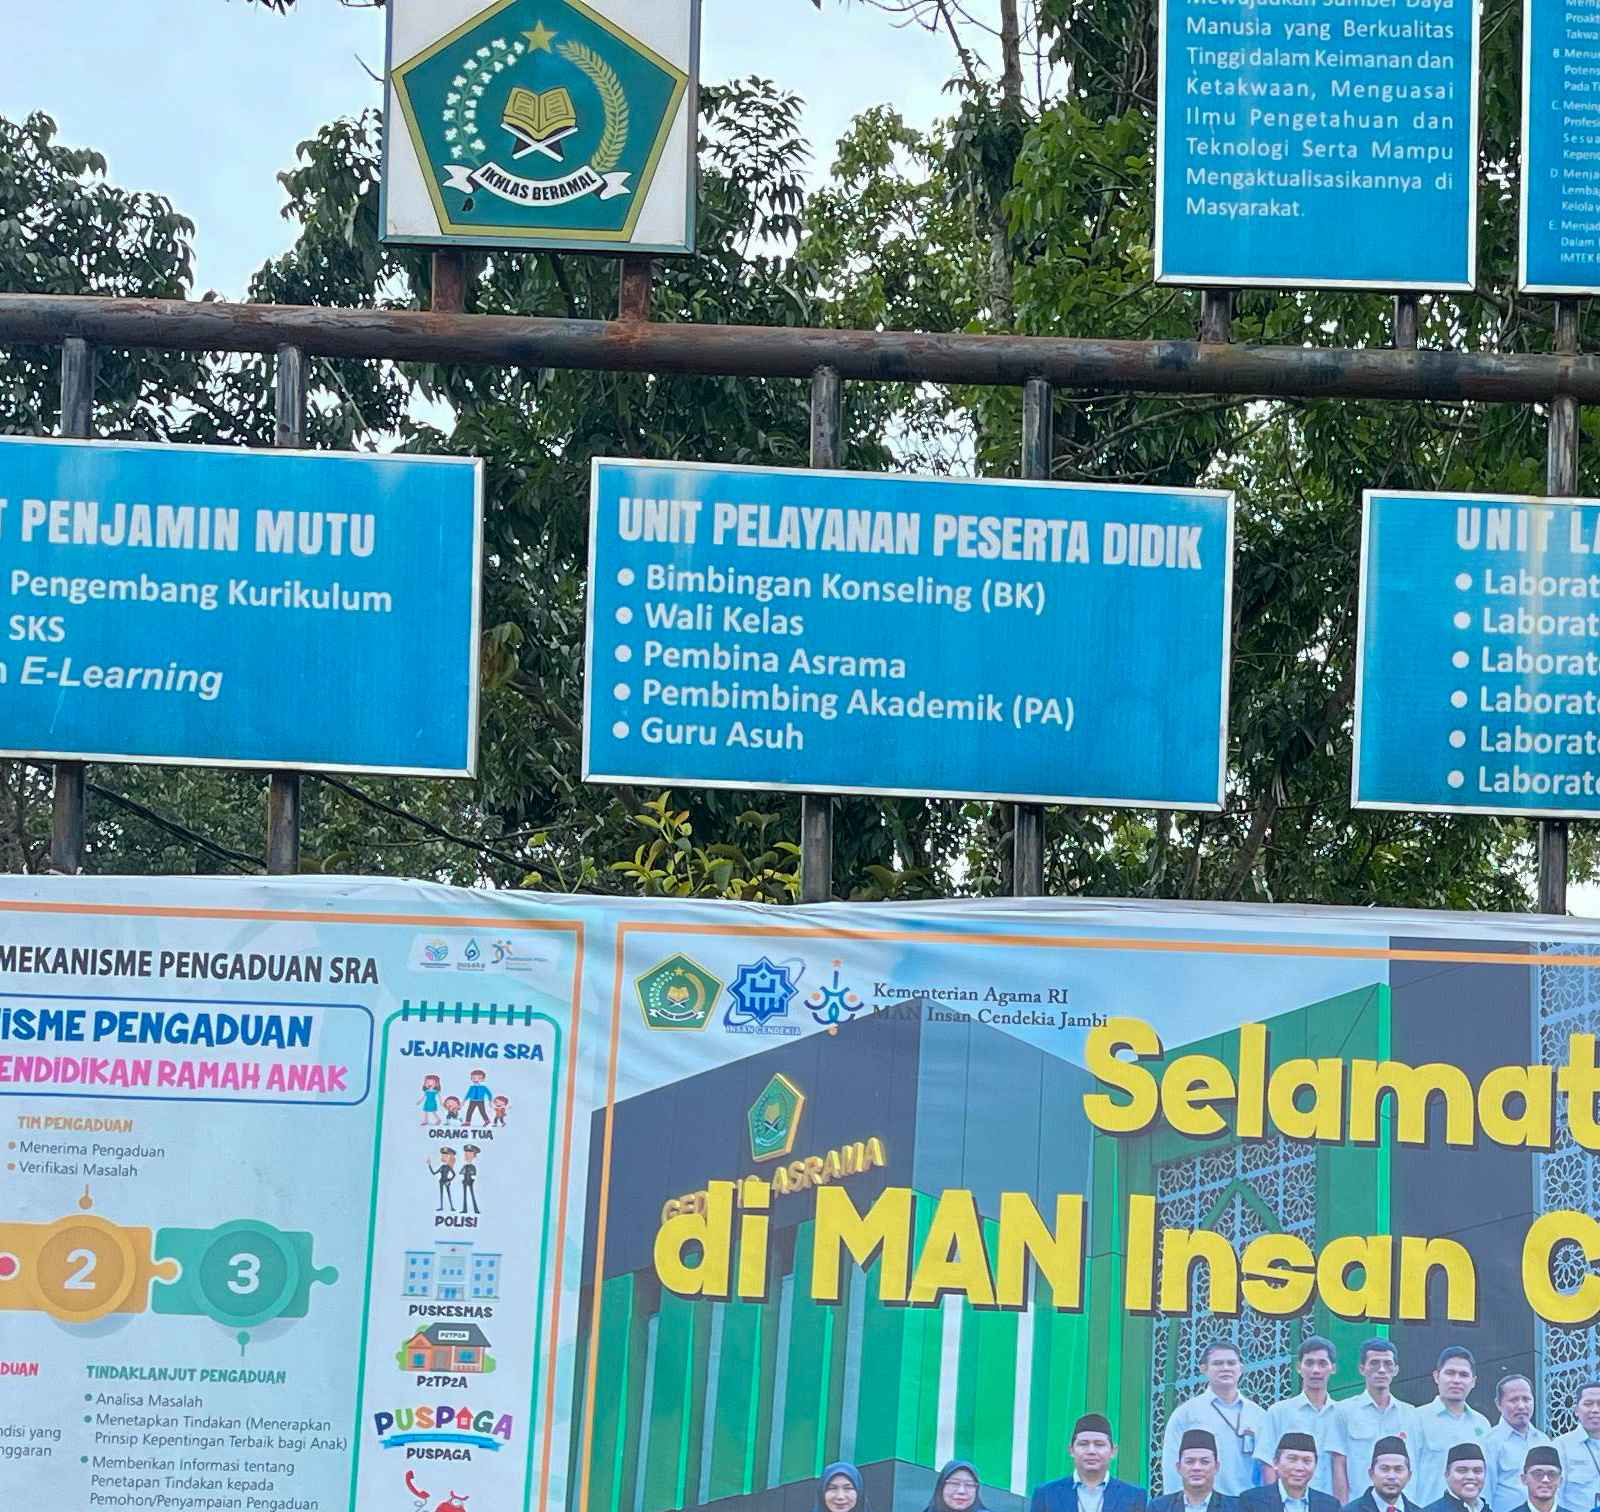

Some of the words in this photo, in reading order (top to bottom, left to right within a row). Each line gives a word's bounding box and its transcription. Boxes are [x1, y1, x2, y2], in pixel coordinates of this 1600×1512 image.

[1187, 17, 1271, 35] Manusia
[1284, 23, 1330, 40] yang
[1344, 20, 1453, 38] Berkualitas
[1187, 77, 1315, 100] Ketakwaan,
[1332, 80, 1453, 102] Menguasai
[1186, 137, 1288, 160] Teknologi
[1303, 139, 1357, 158] Serta
[1372, 141, 1452, 163] Mampu
[480, 167, 529, 198] IKHLAS
[532, 172, 597, 200] BERAMAL
[1187, 168, 1421, 192] Mengaktualisasikannya
[1435, 173, 1452, 189] di
[22, 499, 239, 551] PENJAMIN
[256, 510, 374, 557] MUTU
[619, 494, 702, 544] UNIT
[714, 503, 920, 555] PELAYANAN
[934, 514, 1089, 563] PESERTA
[1103, 523, 1202, 569] DIDIK
[1455, 507, 1555, 553] UNIT
[11, 570, 218, 610] Pengembang
[229, 580, 391, 612] Kurikulum
[647, 564, 811, 602] Bimbingan
[823, 573, 972, 612] Konseling
[982, 580, 1045, 615] (BK)
[10, 615, 65, 642] SKS
[645, 603, 712, 630] Wali
[724, 607, 803, 635] Kelas
[645, 640, 778, 672] Pembina
[789, 648, 905, 678] Asrama
[21, 656, 222, 700] E-Learning
[644, 679, 838, 721] Pembimbing
[847, 688, 1003, 721] Akademik
[1013, 695, 1074, 731] (PA)
[641, 717, 716, 745] Guru
[727, 721, 803, 749] Asuh
[0, 945, 152, 977] MEKANISME
[160, 951, 322, 982] PENGADUAN
[329, 957, 378, 984] SRA
[874, 983, 978, 1004] Kementerian
[984, 987, 1041, 1006] Agama
[1048, 989, 1068, 1004] RI
[0, 1008, 86, 1041] ISME
[93, 1011, 312, 1048] PENGADUAN
[873, 1004, 922, 1022] MAN
[927, 1007, 971, 1023] Insan
[978, 1009, 1056, 1026] Cendekia
[1058, 1011, 1108, 1030] Jambi
[400, 1040, 498, 1058] JEJARING
[504, 1044, 543, 1061] SRA
[158, 1061, 260, 1090] RAMAH
[267, 1064, 347, 1093] ANAK
[16, 1116, 41, 1132] TIM
[44, 1116, 133, 1136] PENGADUAN
[429, 1129, 468, 1139] ORANG
[471, 1130, 493, 1140] TUA
[20, 1141, 87, 1155] Menerima
[92, 1144, 164, 1159] Pengaduan
[19, 1161, 78, 1175] Verifikasi
[83, 1164, 137, 1176] Masalah
[435, 1216, 477, 1227] POLISI
[654, 1180, 772, 1302] di
[811, 1185, 1083, 1309] MAN
[1125, 1193, 1478, 1324] Insan
[64, 1249, 96, 1289] 2
[228, 1253, 260, 1294] 3
[409, 1305, 492, 1318] PUSKESMAS
[86, 1365, 197, 1381] TINDAKLANJUT
[200, 1369, 286, 1384] PENGADUAN
[417, 1376, 467, 1388] P2TP2A
[96, 1393, 143, 1406] Analisa
[149, 1394, 202, 1408] Masalah
[96, 1413, 178, 1429] Menetapkan
[183, 1416, 241, 1429] Tindakan
[246, 1416, 330, 1433] (Menerapkan
[407, 1448, 471, 1461] PUSPAGA
